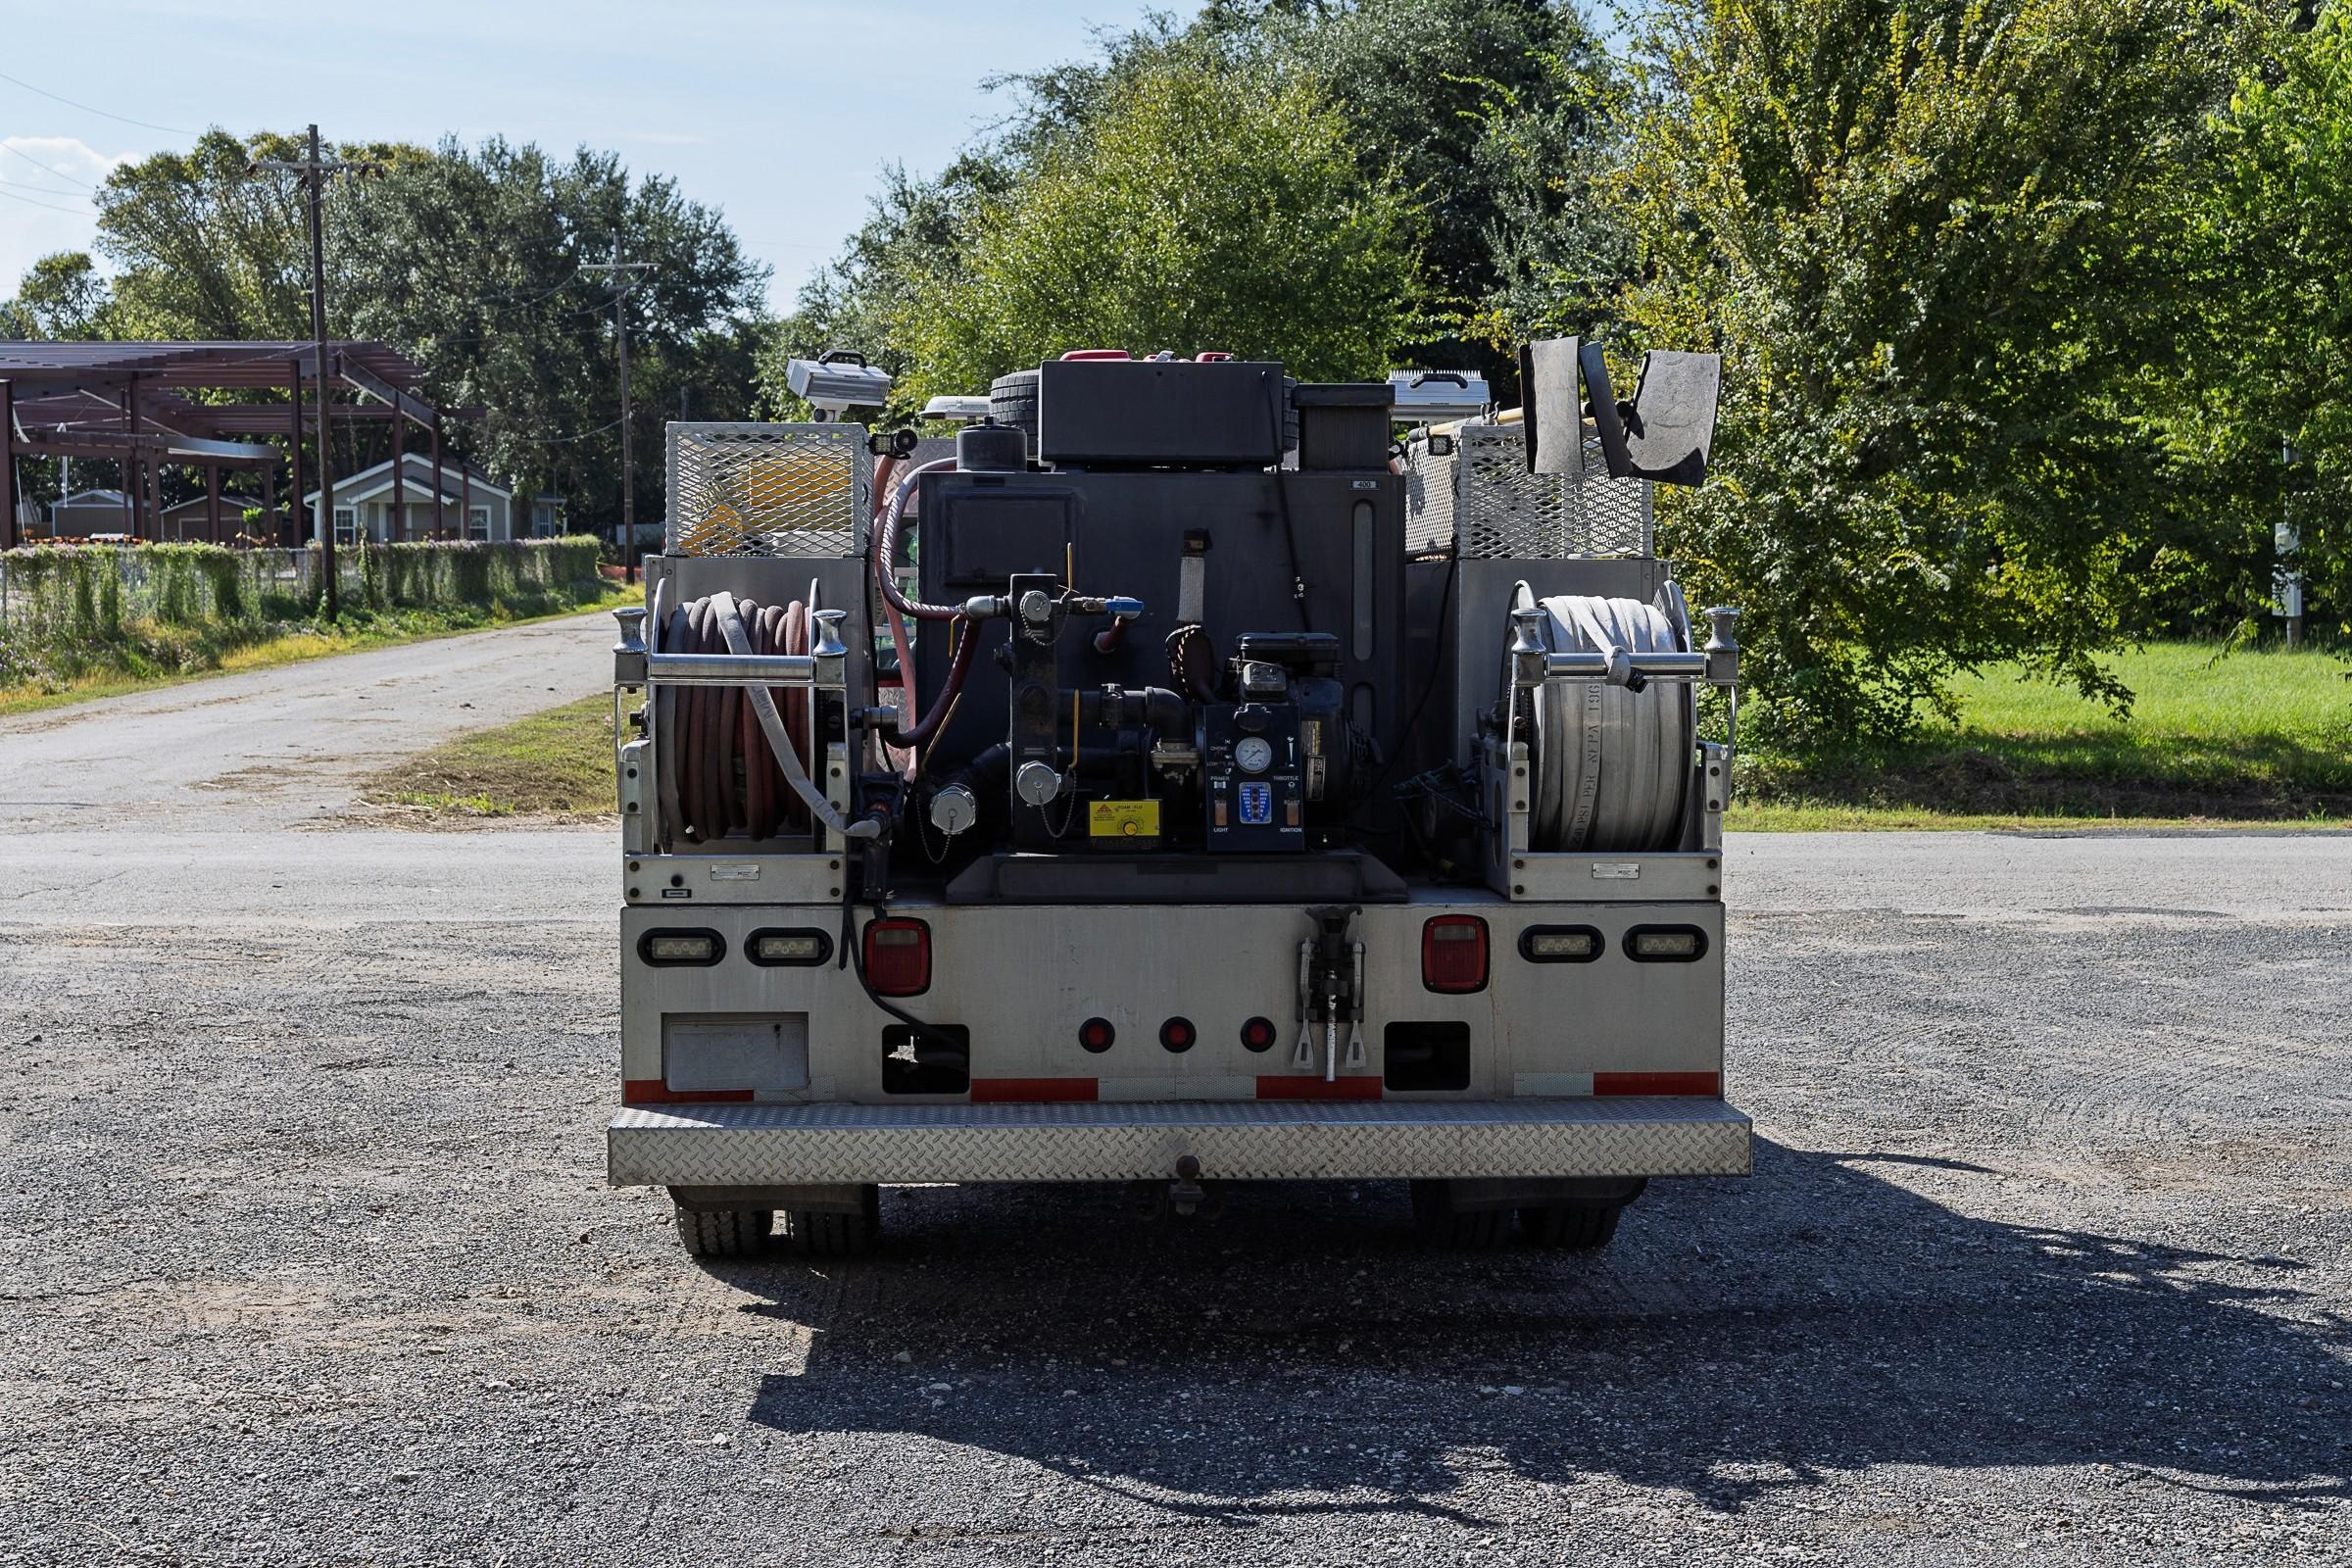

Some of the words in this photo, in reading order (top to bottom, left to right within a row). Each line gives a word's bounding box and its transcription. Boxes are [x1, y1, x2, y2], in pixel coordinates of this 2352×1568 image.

[1587, 723, 1600, 763] NFPA
[1583, 775, 1596, 798] PER
[1576, 805, 1590, 824] PSI
